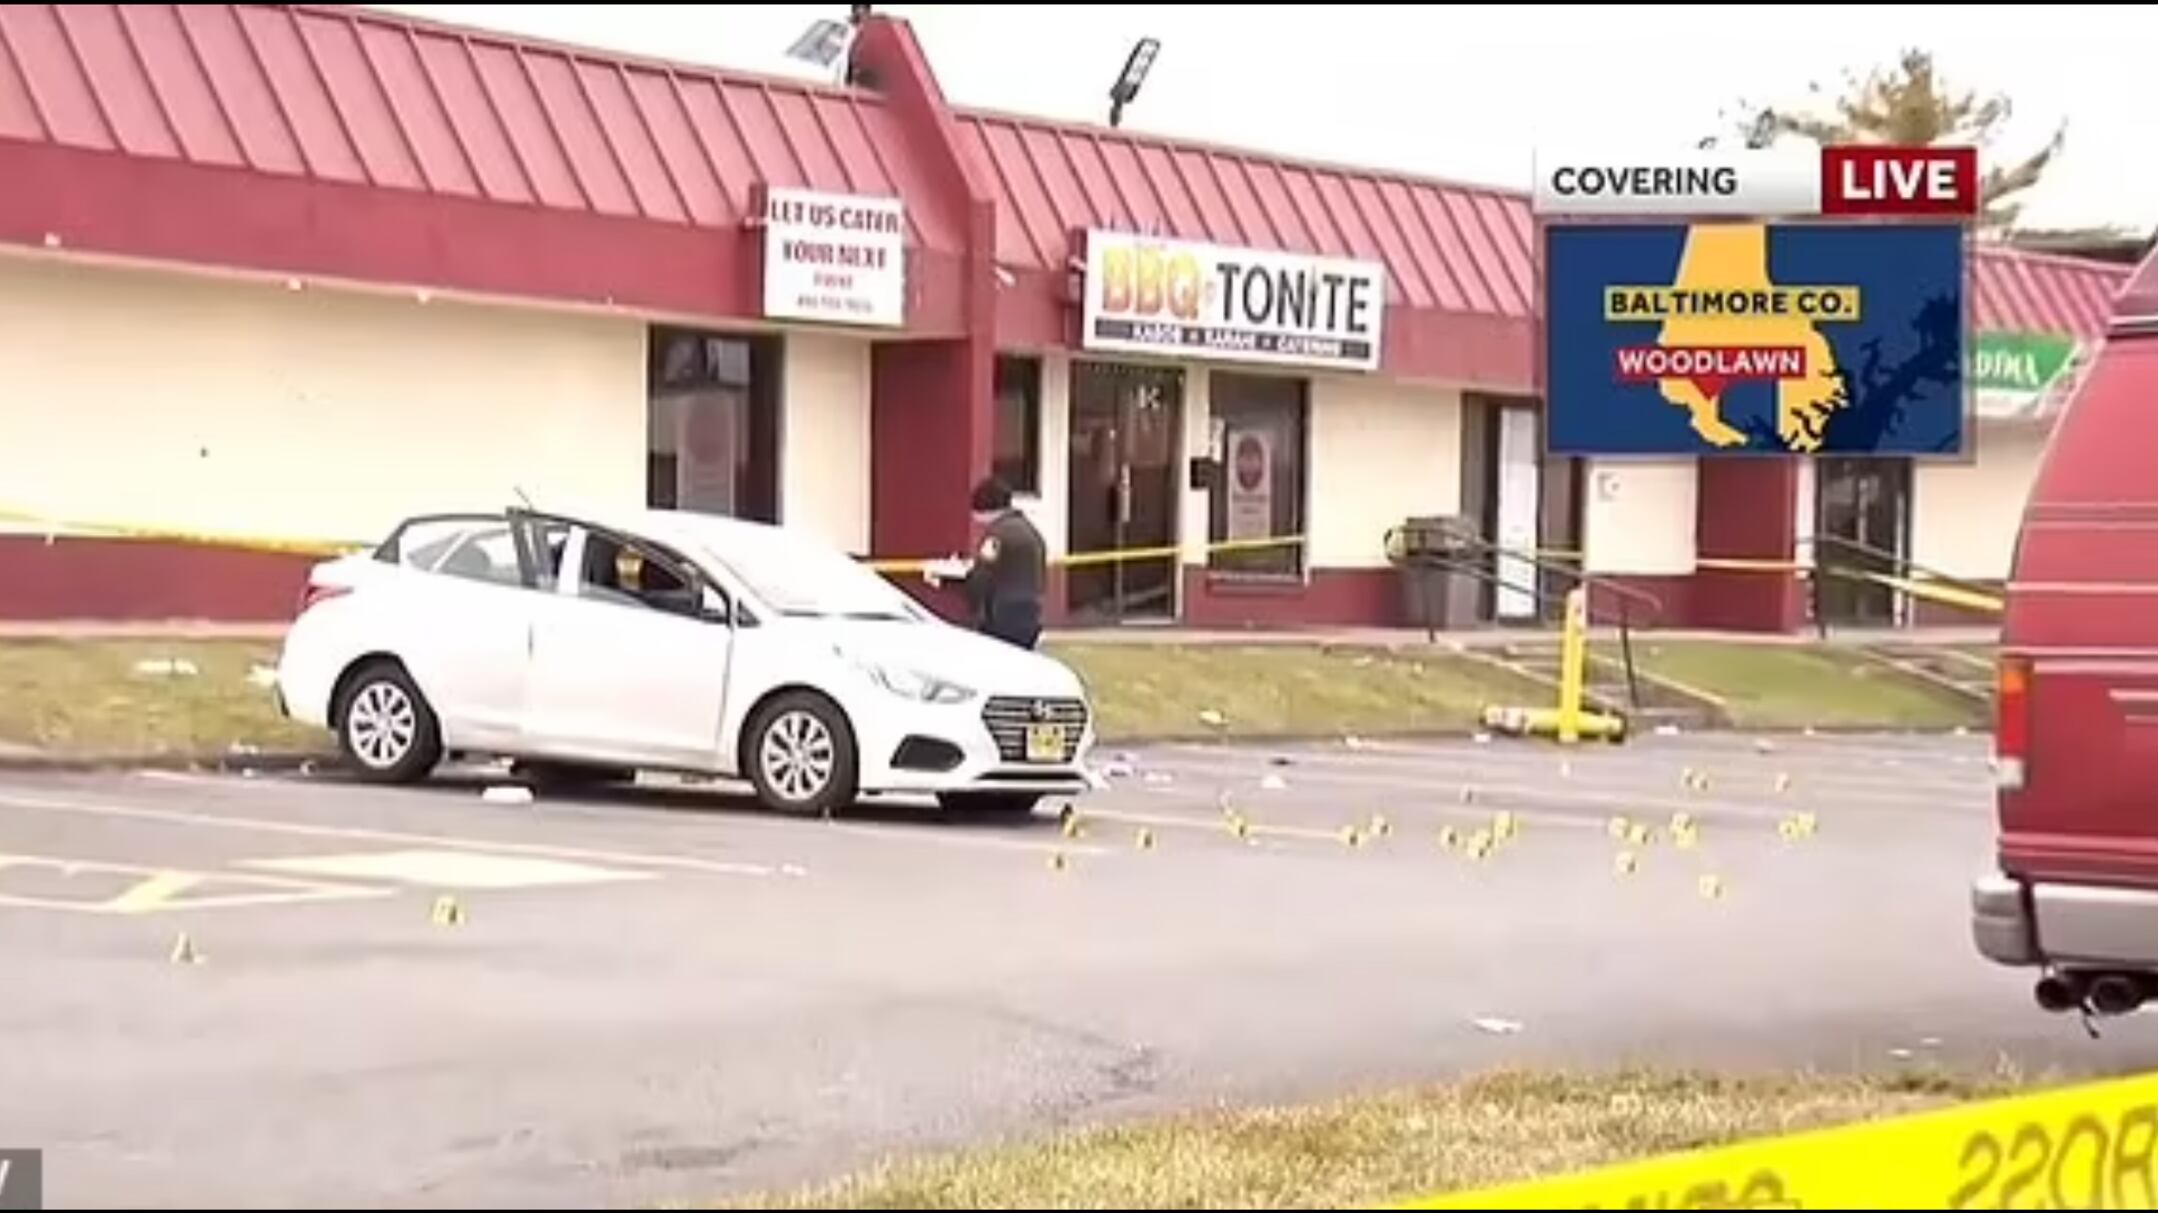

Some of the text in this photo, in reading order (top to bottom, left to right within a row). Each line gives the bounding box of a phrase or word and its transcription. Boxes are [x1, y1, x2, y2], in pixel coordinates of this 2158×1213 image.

[771, 199, 804, 225] LET
[809, 203, 836, 228] US
[1101, 245, 1371, 334] BBQ TONITE
